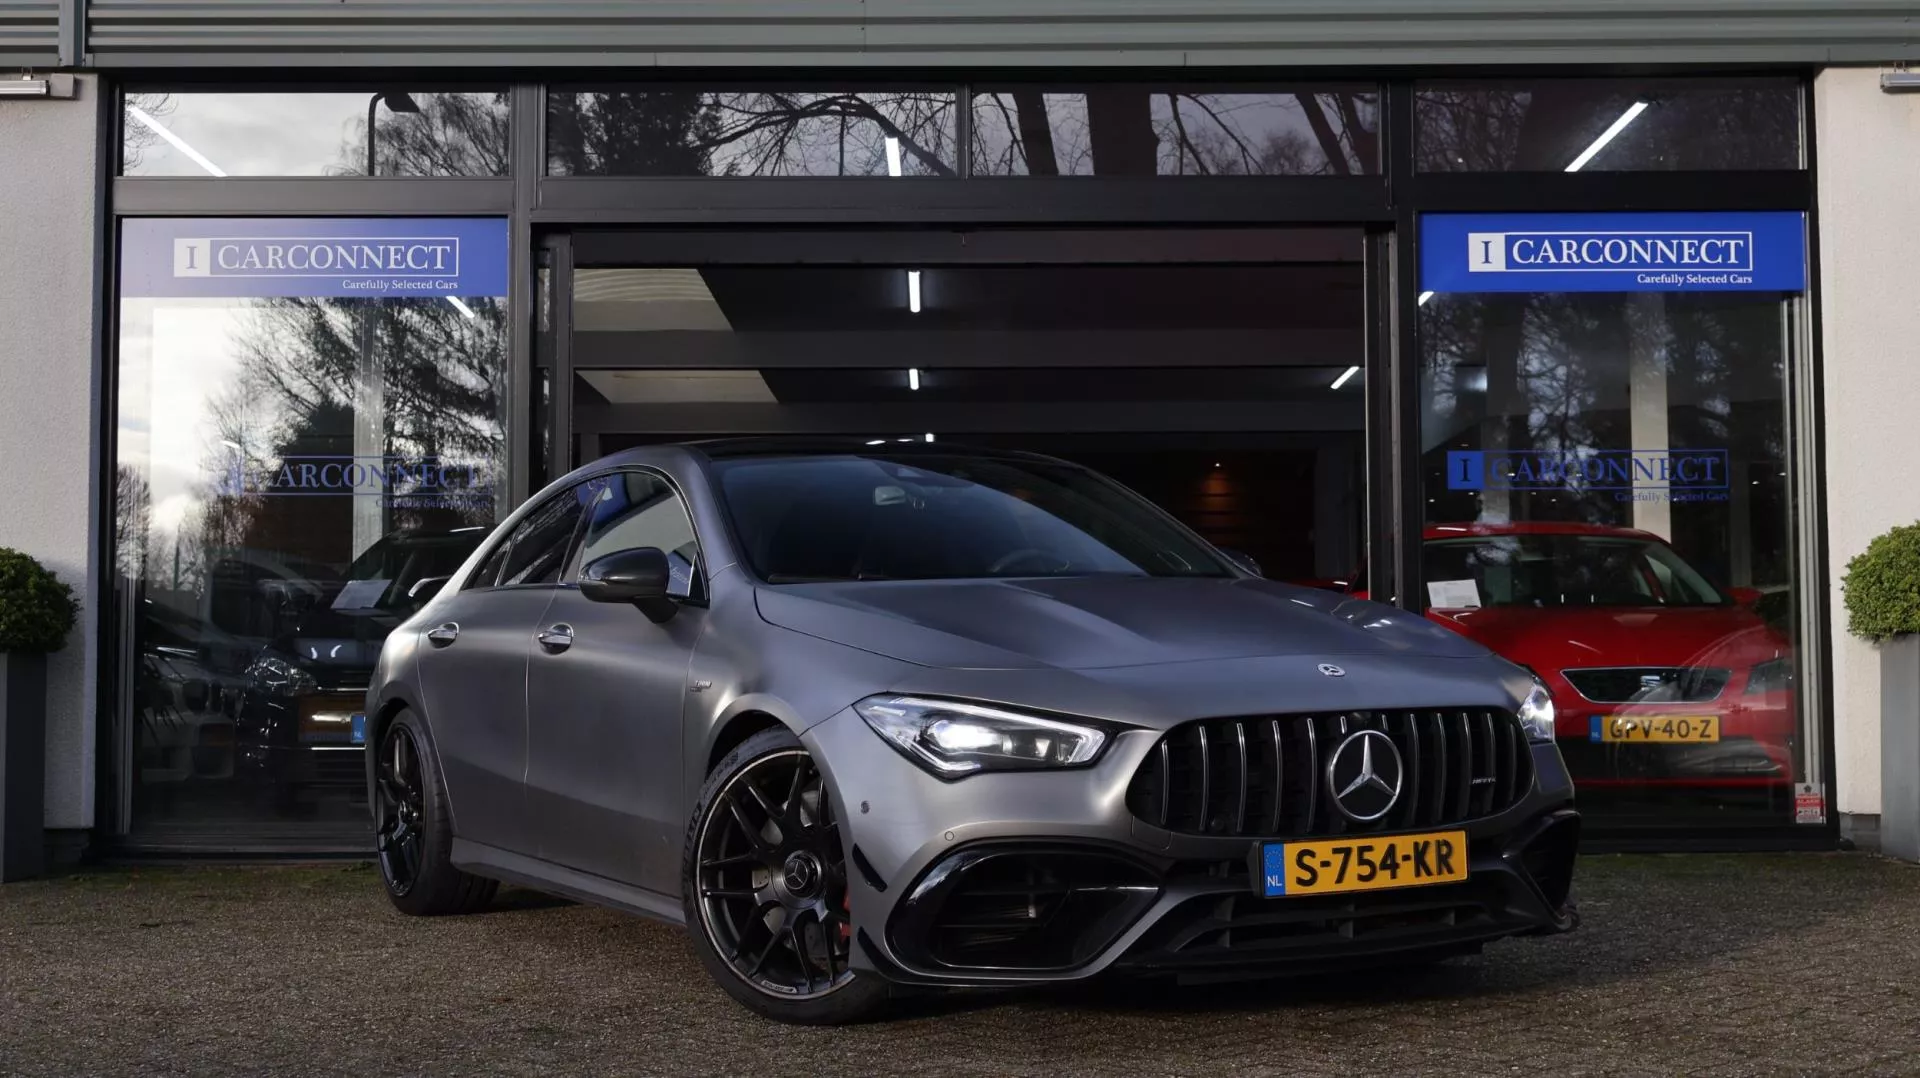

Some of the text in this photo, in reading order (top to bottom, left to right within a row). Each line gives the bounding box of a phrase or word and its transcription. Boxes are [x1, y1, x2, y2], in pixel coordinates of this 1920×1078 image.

[185, 245, 450, 270] I CARCONNECT
[1481, 239, 1744, 264] I CARCONNECT
[342, 279, 458, 292] Carefully Selected Cars
[1637, 274, 1752, 286] Carefully Selected Cars
[1490, 457, 1720, 482] CARCONNECT
[1610, 719, 1711, 739] GPV-40-Z
[1267, 839, 1455, 887] NL S-754-KR
